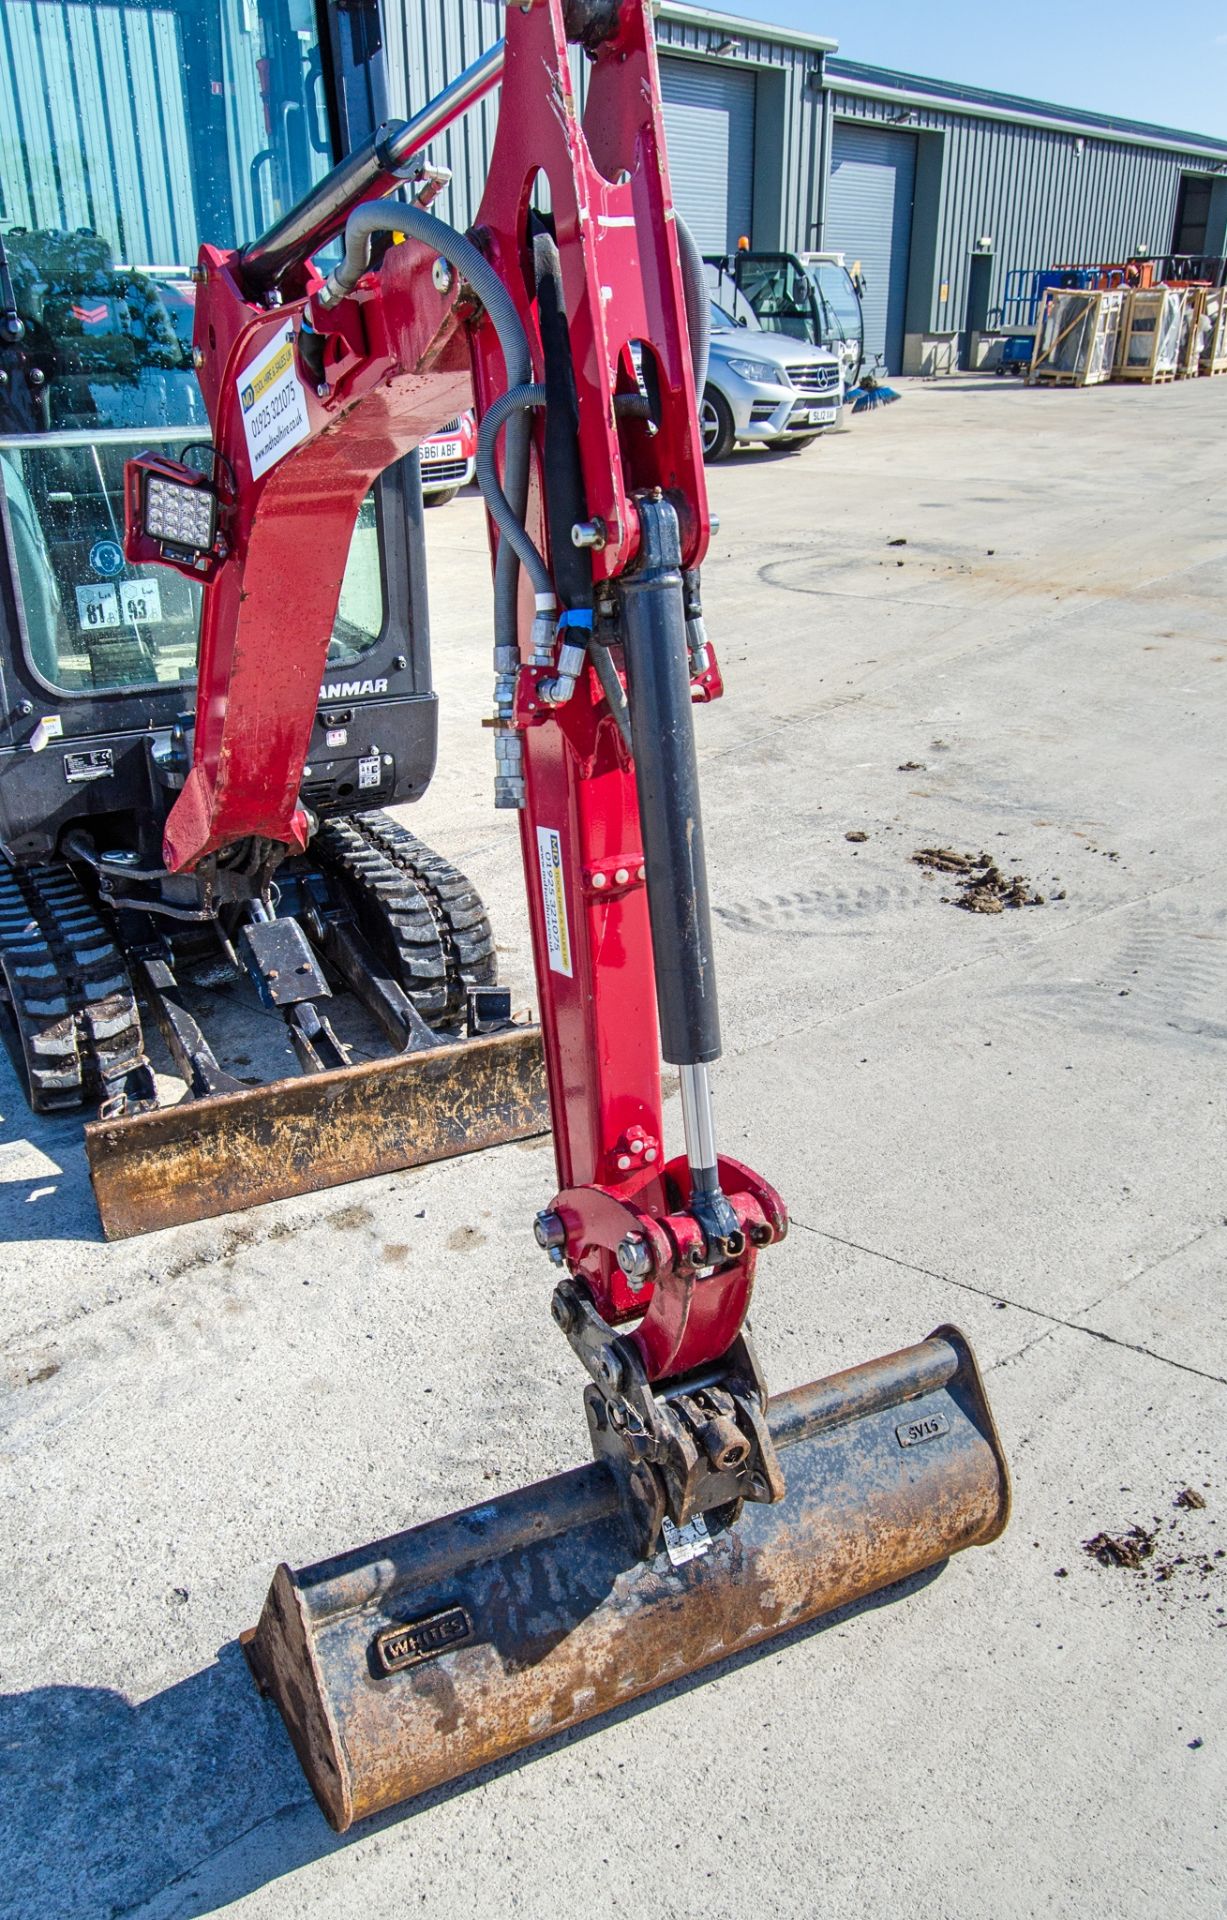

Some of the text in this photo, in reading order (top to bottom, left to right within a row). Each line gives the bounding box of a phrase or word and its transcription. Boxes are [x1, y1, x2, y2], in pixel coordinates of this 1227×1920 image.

[242, 386, 254, 411] MD
[251, 380, 297, 438] 01925 321075
[254, 409, 303, 463] www.mdtoolhire.co.uk
[441, 443, 456, 456] ABF
[86, 603, 105, 625] 81
[127, 598, 147, 620] 93
[318, 678, 388, 699] ANMAR
[551, 836, 559, 867] MD
[540, 845, 554, 953] www.mdtoolhire.co.uk
[545, 851, 560, 951] 01925 321075
[387, 1618, 464, 1658] WHITES
